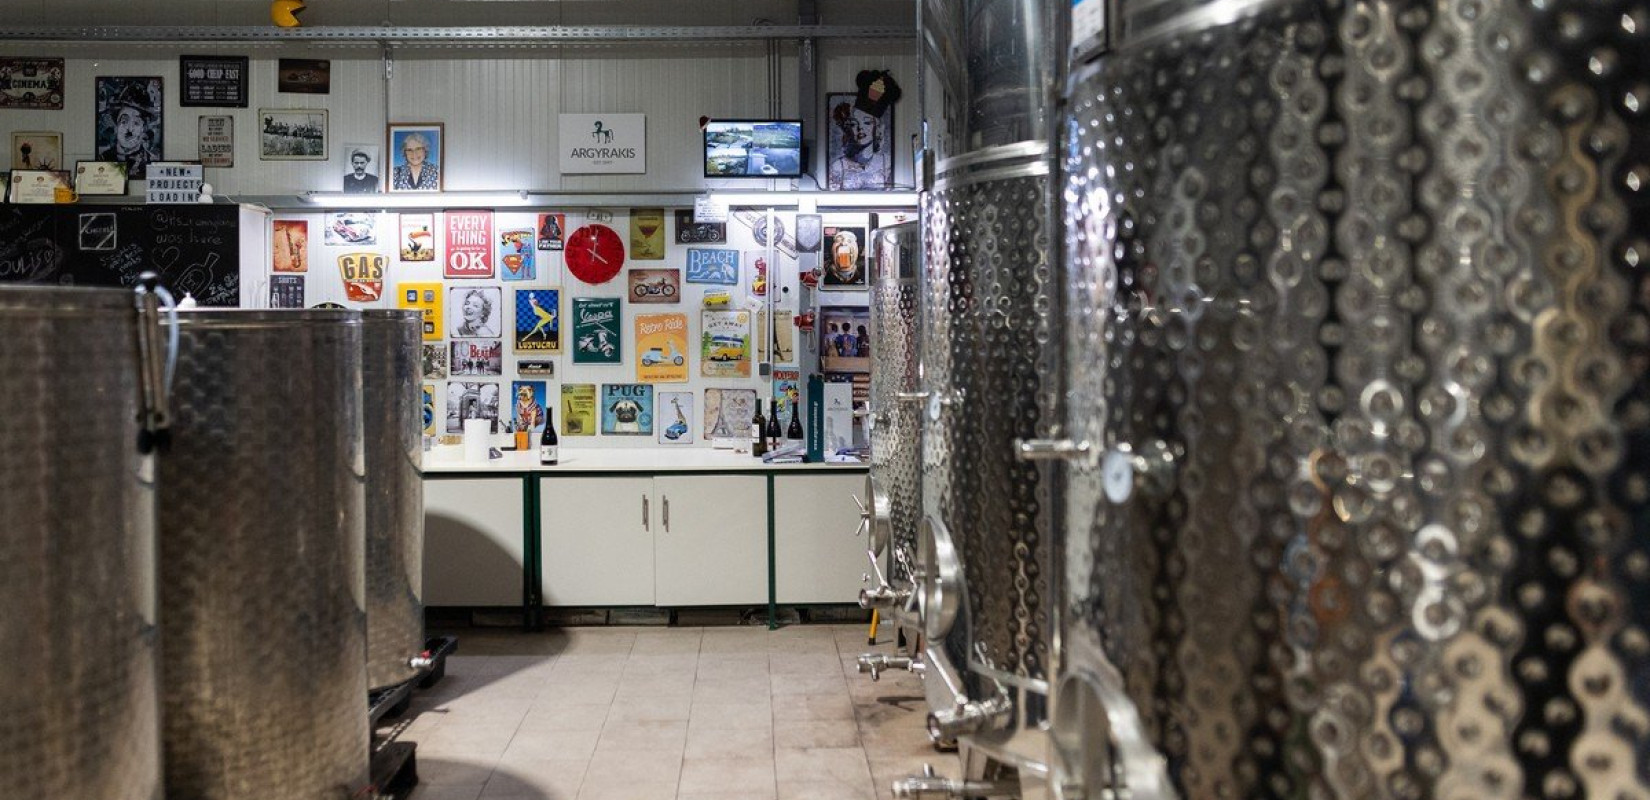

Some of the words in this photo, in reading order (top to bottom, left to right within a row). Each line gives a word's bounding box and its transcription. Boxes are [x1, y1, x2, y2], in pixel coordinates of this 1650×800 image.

[12, 80, 46, 88] CINEMA
[571, 148, 635, 158] ARGYRAKIS
[166, 168, 185, 176] NEW
[150, 180, 201, 189] PROJECTS
[451, 215, 487, 230] EVERY
[156, 234, 182, 244] was
[451, 231, 486, 245] THING
[451, 252, 488, 270] OK
[689, 250, 735, 273] BEACH
[343, 257, 383, 279] GAS
[640, 322, 662, 335] Retro
[664, 318, 683, 331] Ride
[608, 384, 645, 396] PUG
